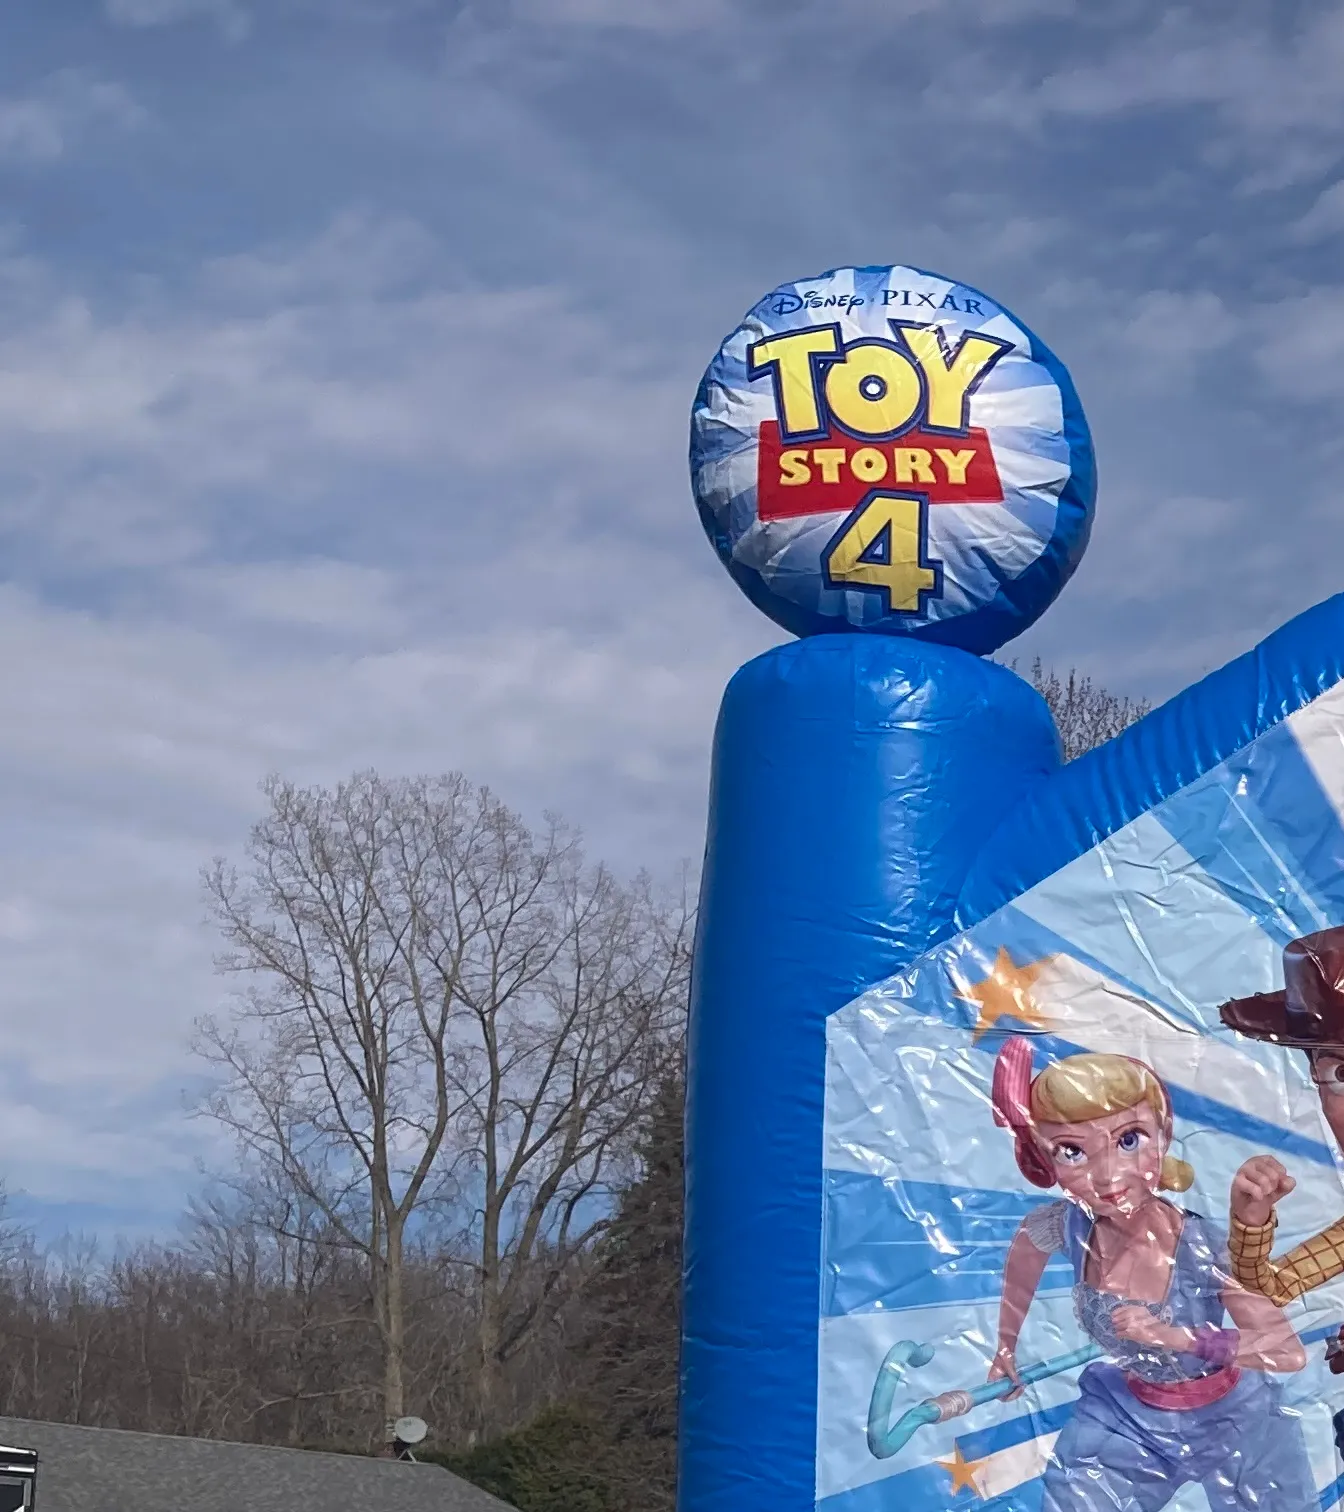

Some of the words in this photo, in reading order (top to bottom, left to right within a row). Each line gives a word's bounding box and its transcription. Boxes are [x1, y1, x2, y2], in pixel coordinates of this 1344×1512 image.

[771, 289, 866, 317] Disney
[880, 289, 985, 317] PIXAR
[746, 318, 1016, 445] TOY
[778, 447, 978, 486] STORY
[820, 487, 944, 615] 4
